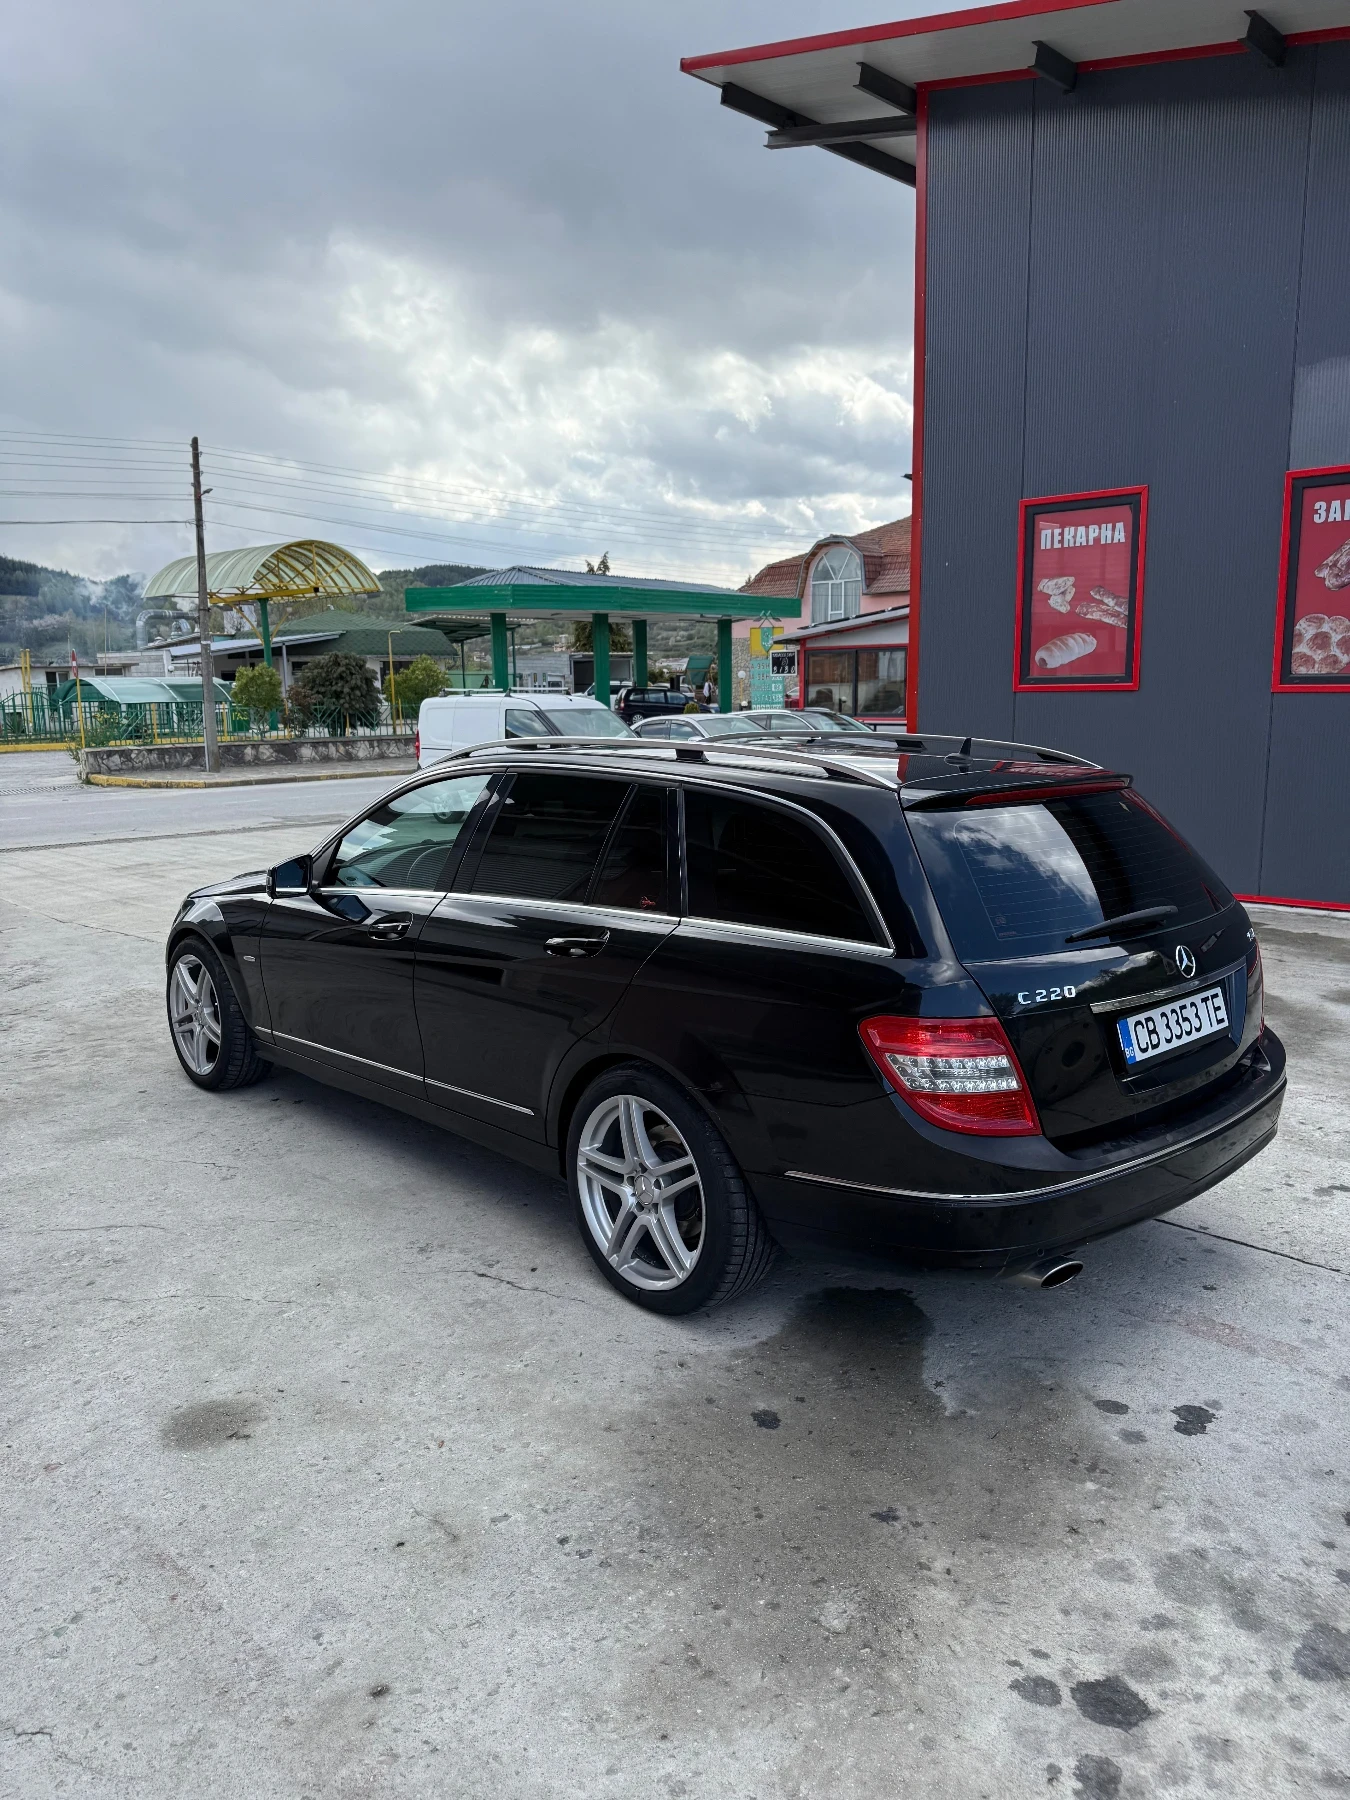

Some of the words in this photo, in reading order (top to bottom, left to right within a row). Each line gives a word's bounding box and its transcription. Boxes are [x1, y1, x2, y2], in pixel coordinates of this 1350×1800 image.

[1040, 522, 1125, 549] ПЕКАРНА
[1134, 1016, 1161, 1054] CB
[1160, 1001, 1203, 1044] 3353
[1201, 992, 1226, 1028] TE
[1125, 1047, 1135, 1058] BG
